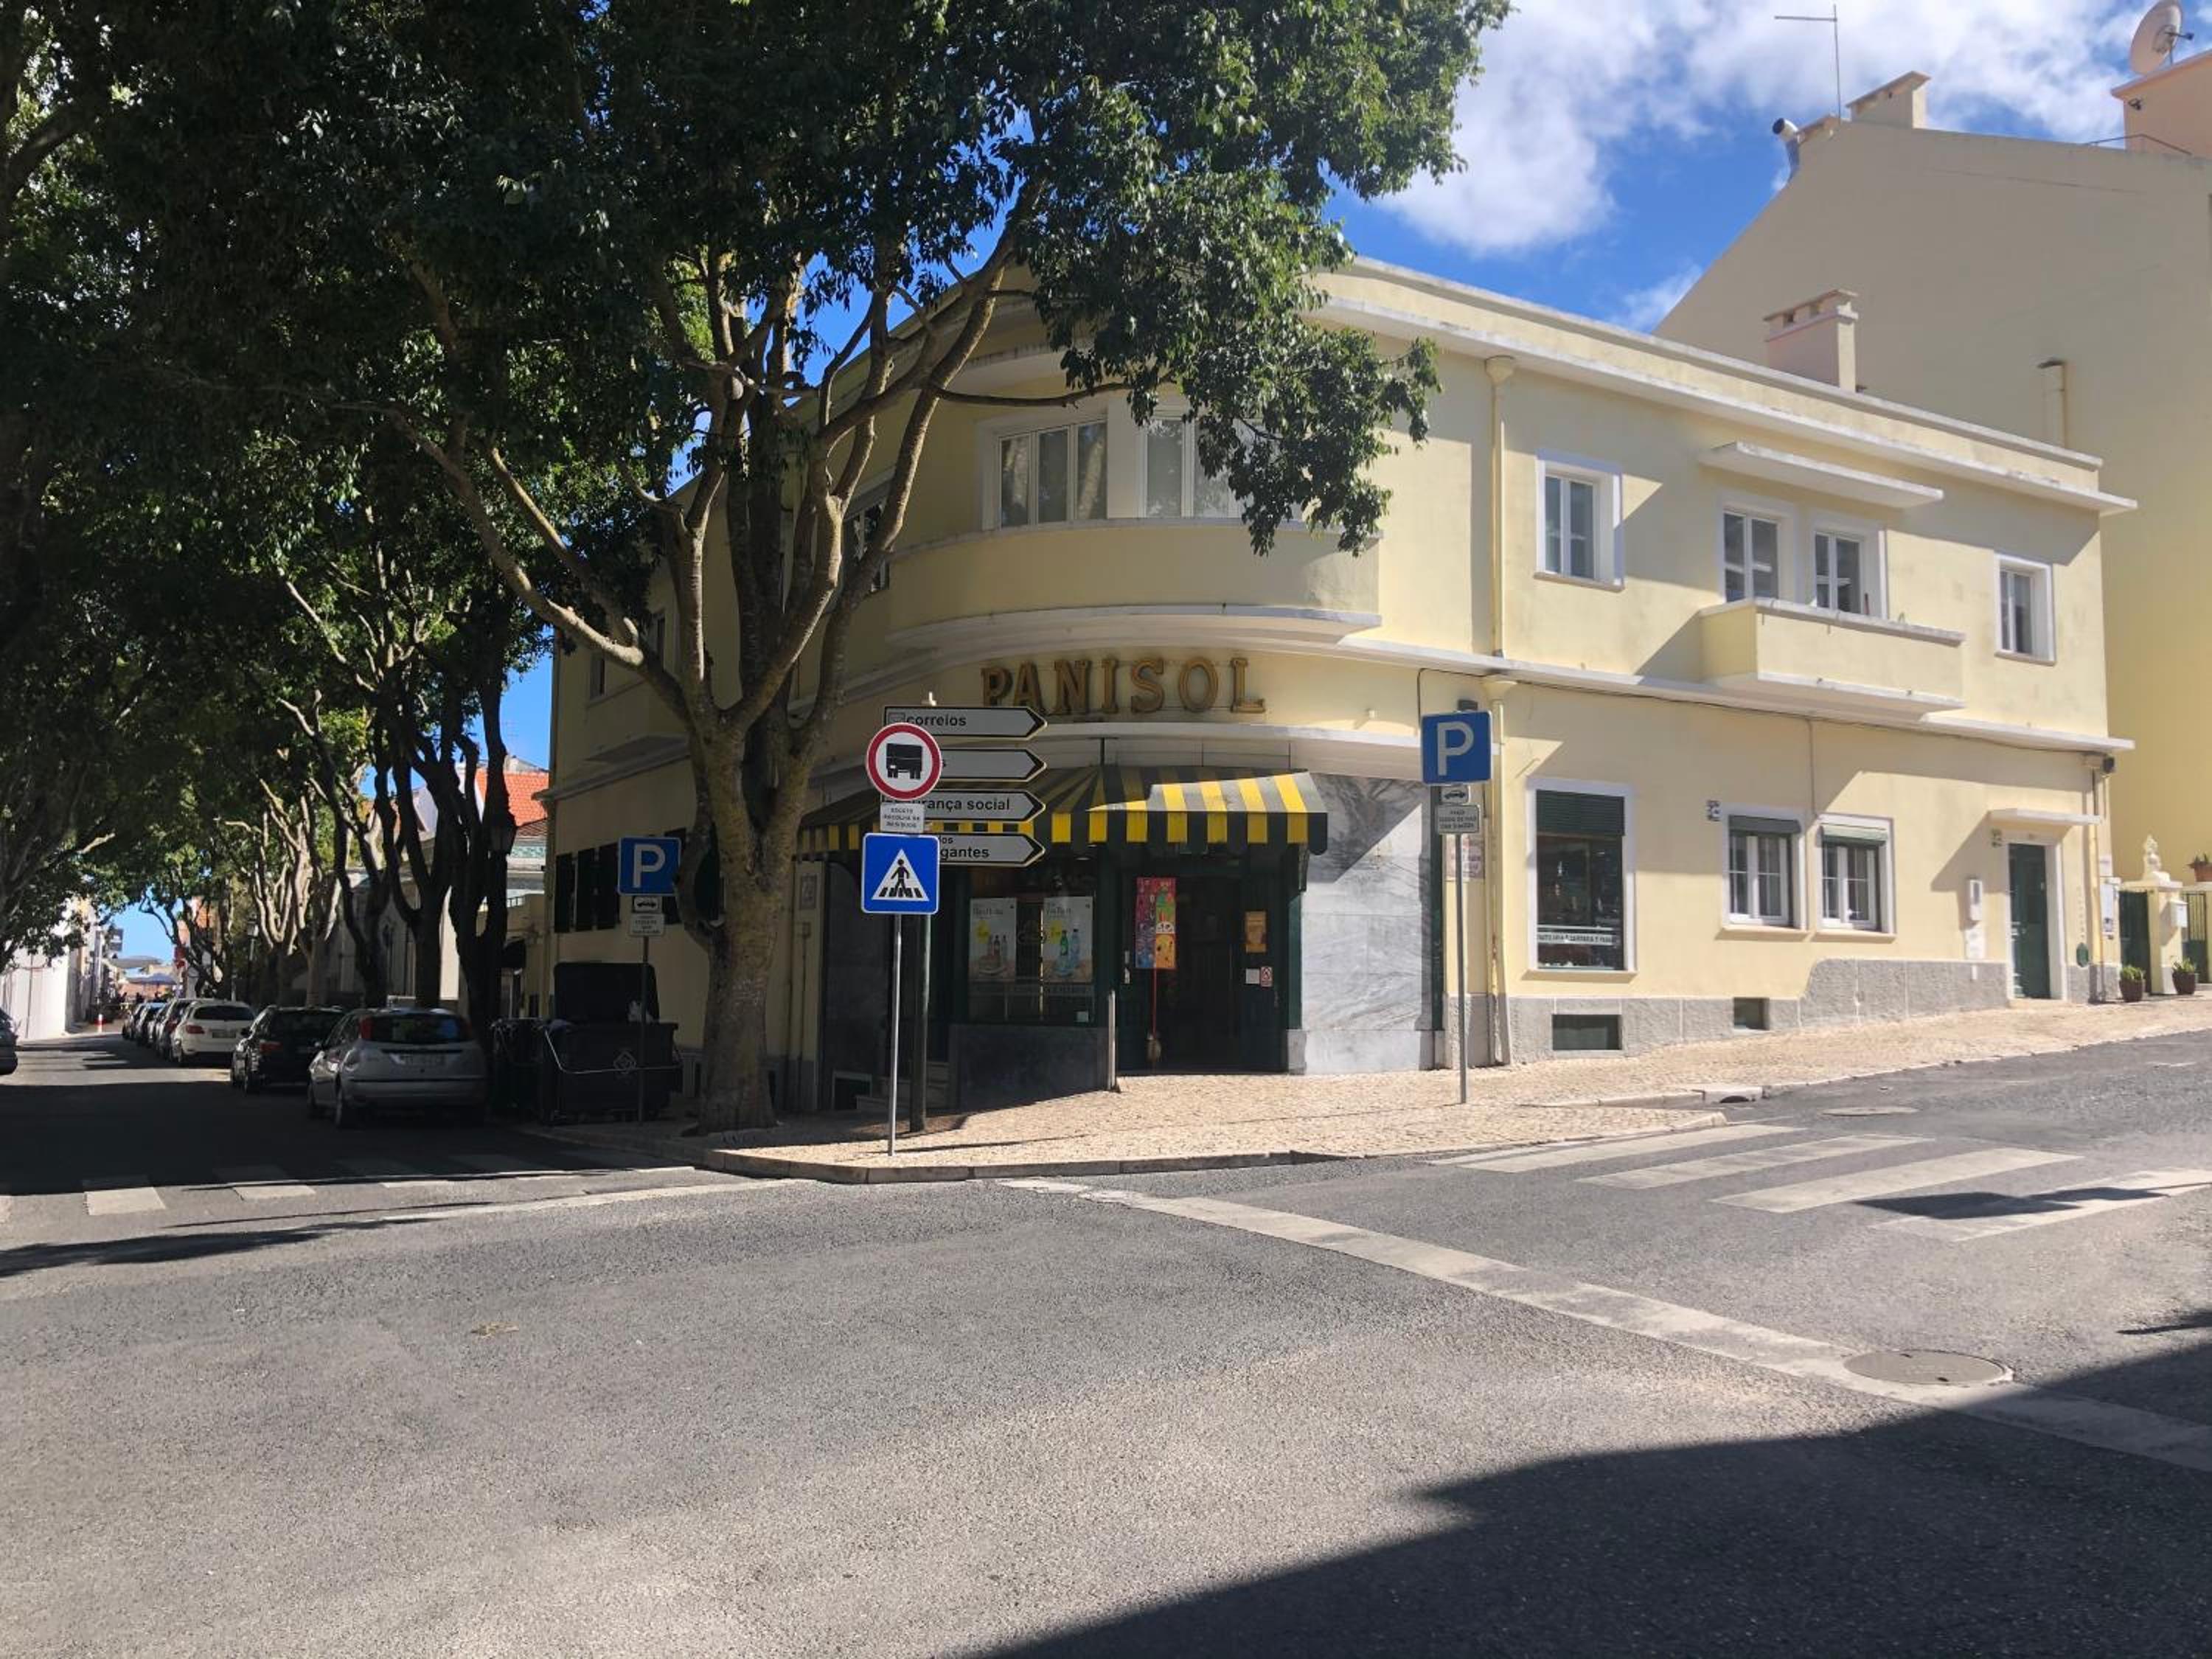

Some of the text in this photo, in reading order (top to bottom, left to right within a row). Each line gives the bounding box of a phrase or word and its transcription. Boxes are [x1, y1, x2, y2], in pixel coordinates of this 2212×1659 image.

[981, 657, 1265, 714] PANISOL
[906, 714, 967, 726] correios
[1437, 722, 1474, 776] P
[967, 799, 1010, 810] social
[633, 844, 666, 888] P
[939, 846, 990, 860] gantes
